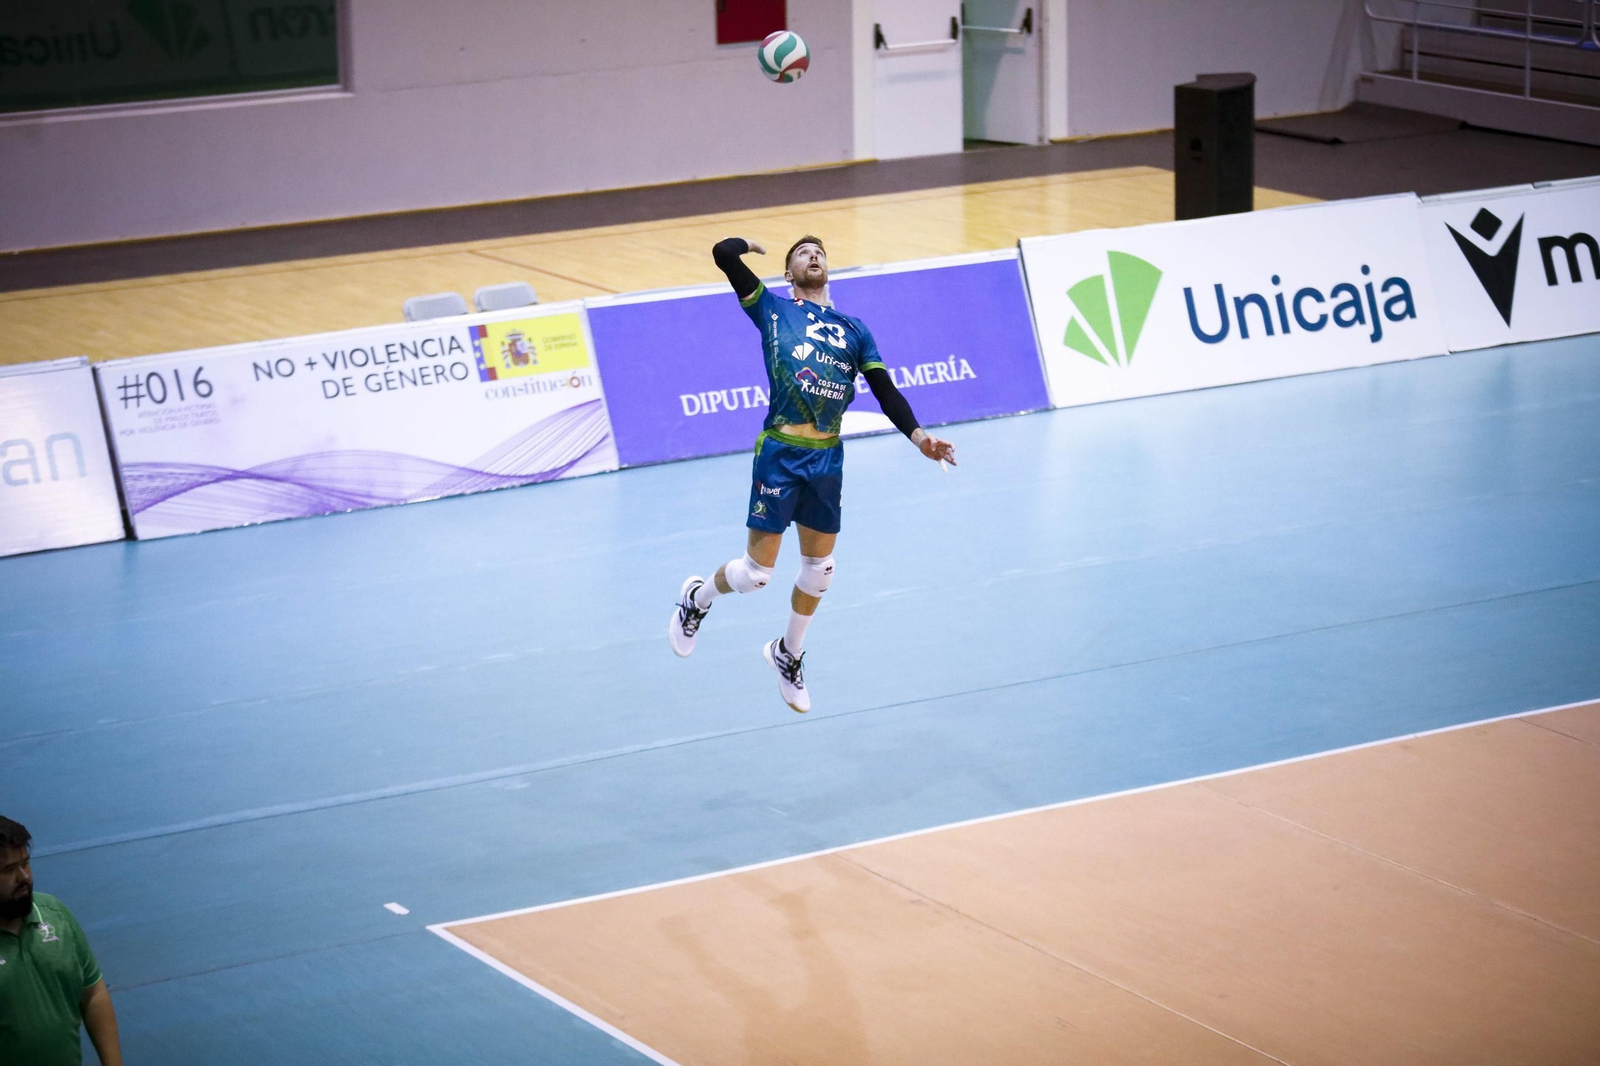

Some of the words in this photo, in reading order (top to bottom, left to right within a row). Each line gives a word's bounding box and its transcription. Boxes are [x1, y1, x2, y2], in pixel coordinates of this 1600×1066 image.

[1182, 264, 1417, 345] Unicaja
[806, 313, 847, 349] 23
[252, 357, 296, 381] NO
[304, 357, 318, 371] +
[322, 335, 465, 371] VIOLENCIA
[117, 366, 213, 410] #016
[321, 376, 357, 399] DE
[364, 361, 469, 393] GÉNERO
[679, 385, 771, 417] DIPUTA
[887, 354, 978, 390] LMERÍA
[809, 385, 844, 400] ALMERÍA
[818, 378, 840, 390] COSTA
